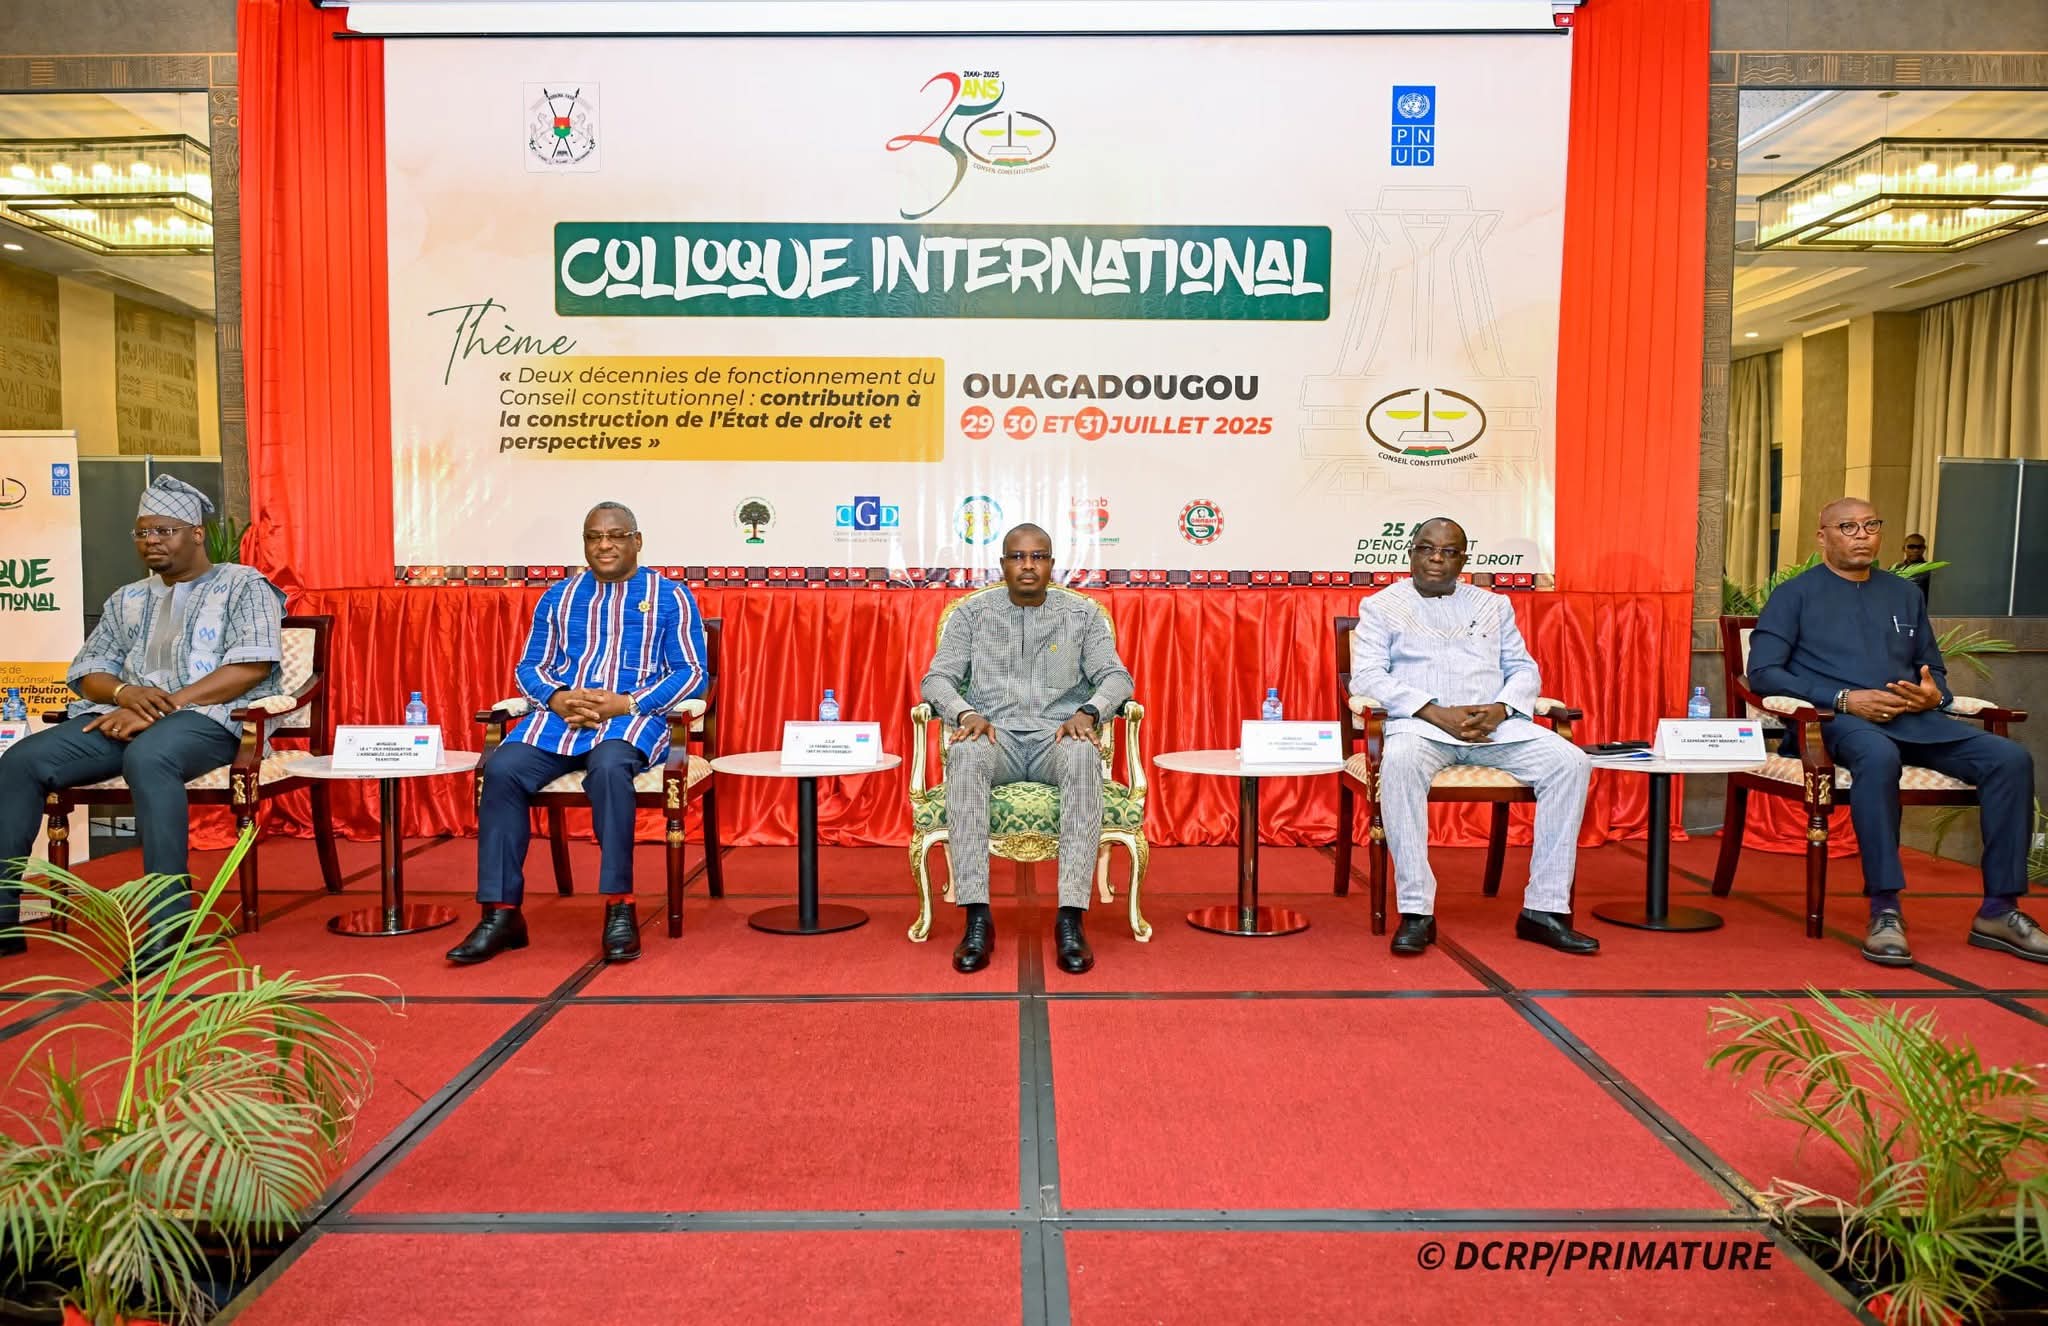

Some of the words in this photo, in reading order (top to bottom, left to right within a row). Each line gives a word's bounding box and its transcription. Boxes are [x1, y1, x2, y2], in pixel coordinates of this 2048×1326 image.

[961, 79, 999, 100] ANS
[561, 237, 860, 301] COLLOQUE
[872, 235, 1324, 297] INTERNATIONAL
[427, 297, 577, 386] Thème
[518, 367, 574, 383] Deux
[579, 366, 688, 384] décennies
[694, 367, 721, 384] de
[727, 367, 902, 384] fonctionnement
[907, 368, 936, 385] du
[963, 373, 1259, 400] OUAGADOUGOU
[500, 388, 577, 405] Conseil
[582, 388, 744, 406] constitutionnel
[760, 388, 900, 407] contribution
[906, 389, 921, 407] à
[500, 410, 521, 427] la
[527, 410, 669, 428] construction
[675, 410, 704, 428] de
[709, 408, 769, 428] l’État
[775, 411, 803, 428] de
[809, 411, 863, 429] droit
[869, 413, 892, 429] et
[964, 414, 993, 433] 29
[1005, 414, 1035, 433] 30
[1043, 415, 1074, 433] ET
[1078, 414, 1104, 434] 31
[1108, 415, 1209, 434] JUILLET
[1213, 416, 1273, 434] 2025
[499, 431, 642, 453] perspectives
[1378, 451, 1409, 465] CONSEIL
[1410, 452, 1479, 467] CONSTITUTIONNEL
[837, 501, 898, 526] CGD
[1381, 522, 1405, 537] 25
[1354, 553, 1398, 565] POUR
[1477, 554, 1524, 566] DROIT
